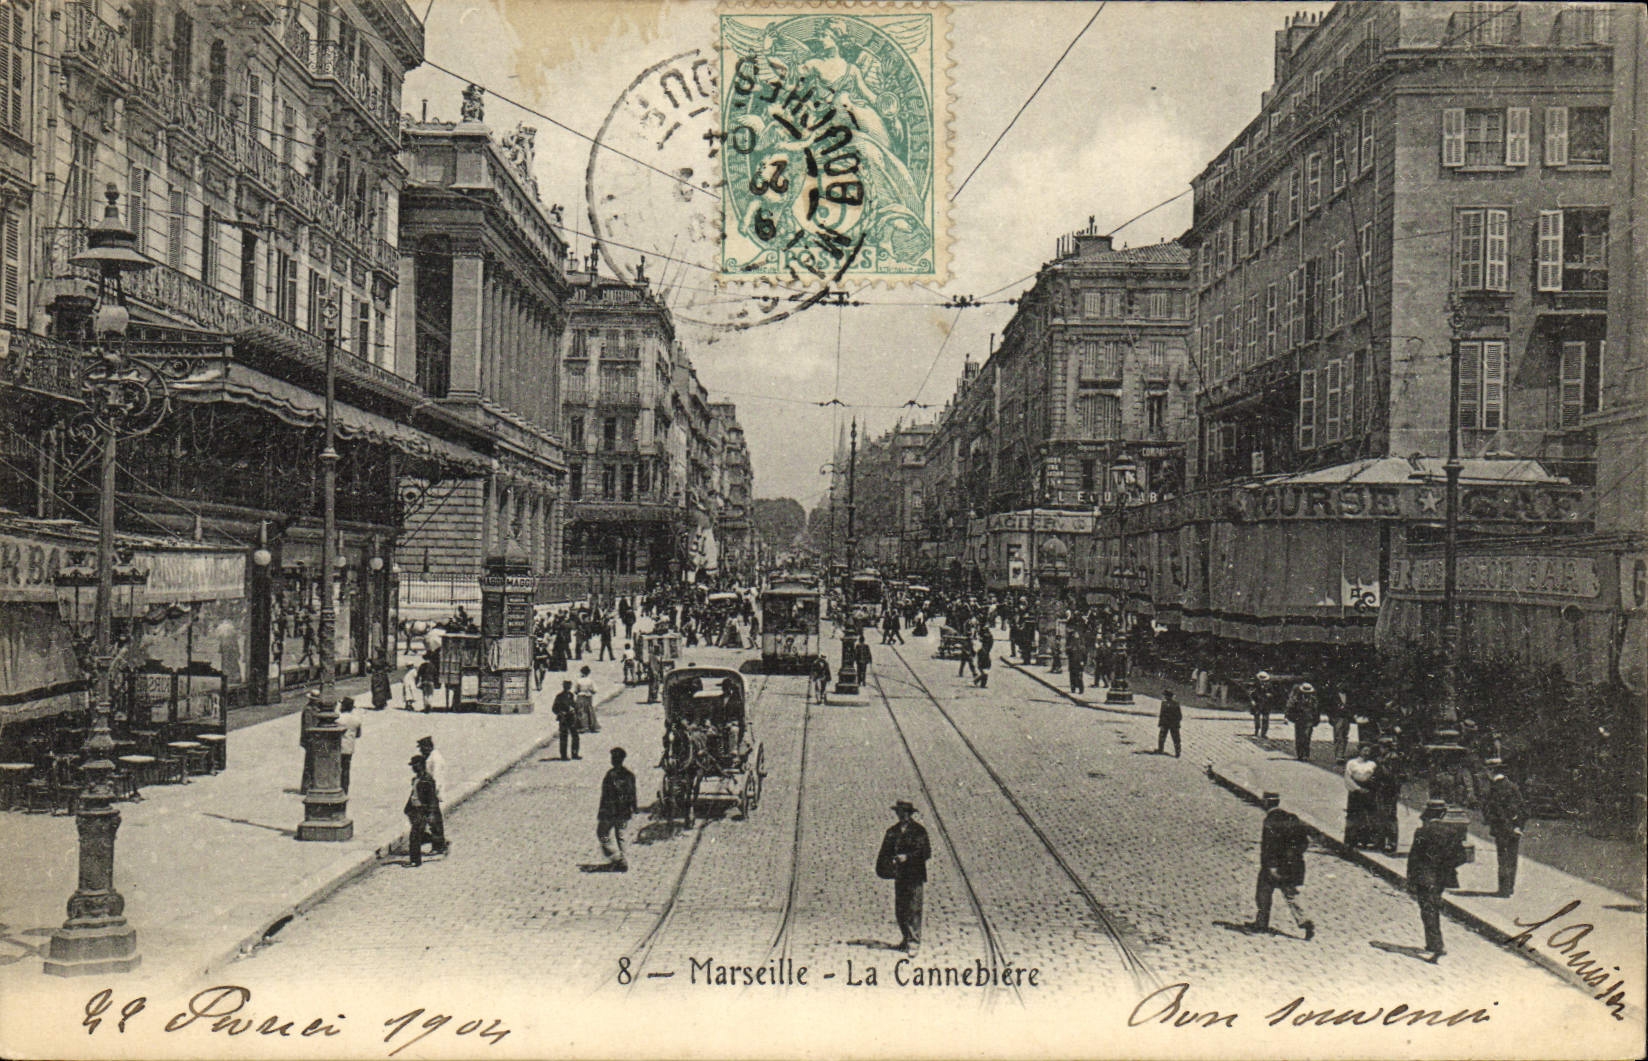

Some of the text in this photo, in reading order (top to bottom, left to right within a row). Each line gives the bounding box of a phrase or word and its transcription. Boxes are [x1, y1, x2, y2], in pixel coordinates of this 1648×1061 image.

[784, 248, 873, 270] POSTES
[1128, 982, 1239, 1028] Bon
[383, 1008, 512, 1057] 1904
